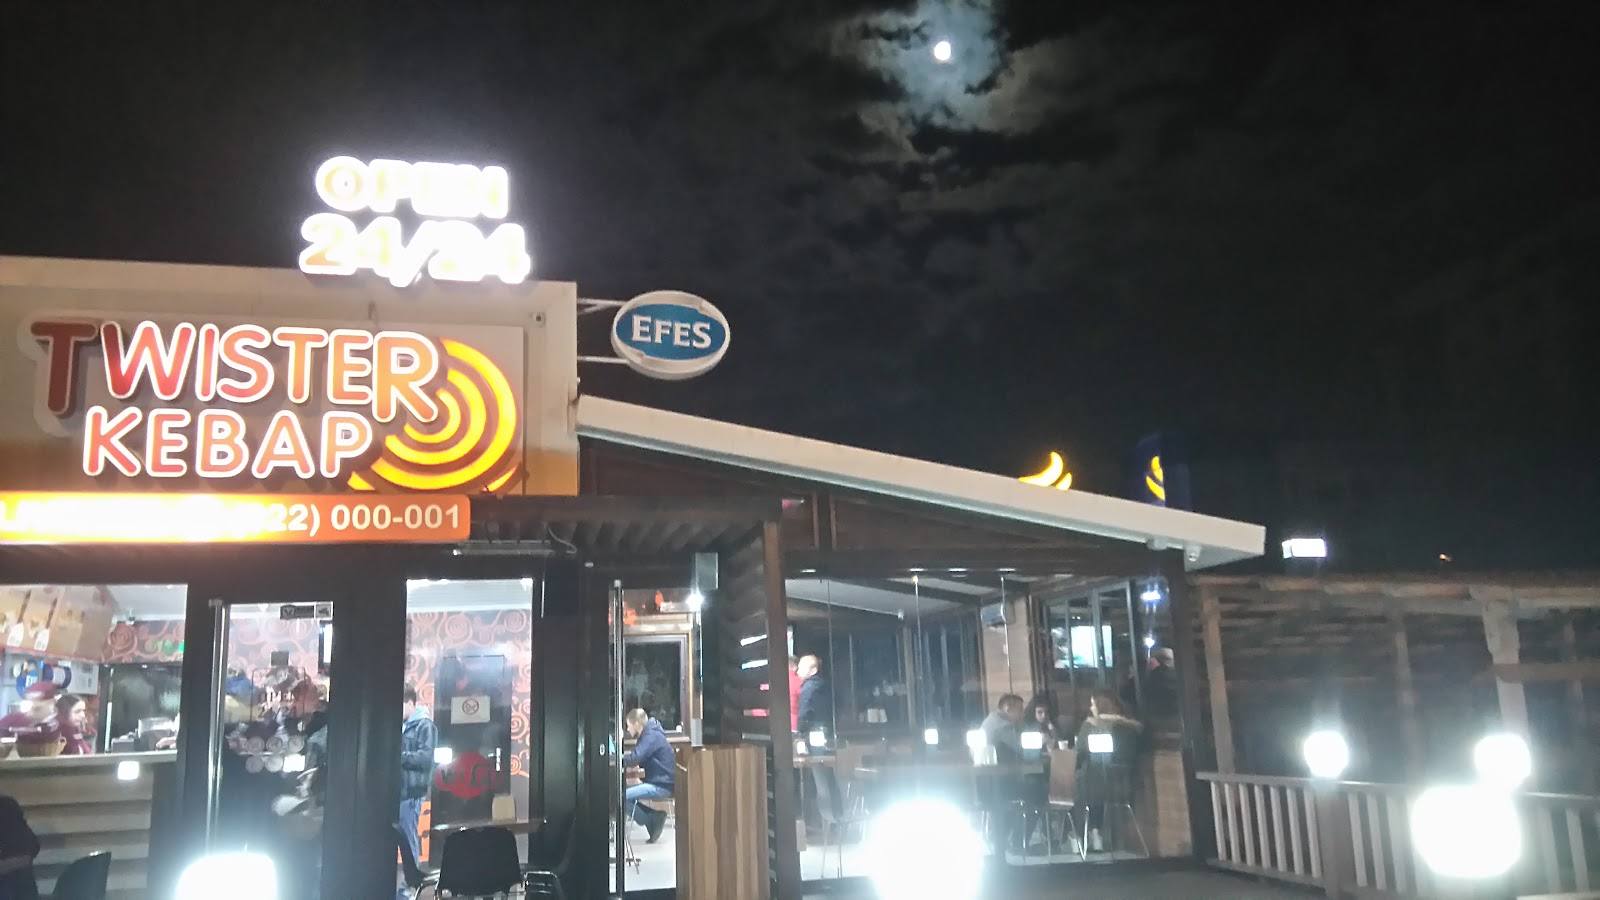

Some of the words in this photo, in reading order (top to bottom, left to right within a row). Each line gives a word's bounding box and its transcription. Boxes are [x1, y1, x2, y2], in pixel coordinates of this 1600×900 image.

[315, 156, 509, 220] OPEN
[299, 212, 531, 287] 24/24
[631, 314, 712, 349] EFES
[30, 320, 440, 423] TWISTER
[82, 405, 373, 478] KEBAP
[330, 503, 459, 531] 000-001
